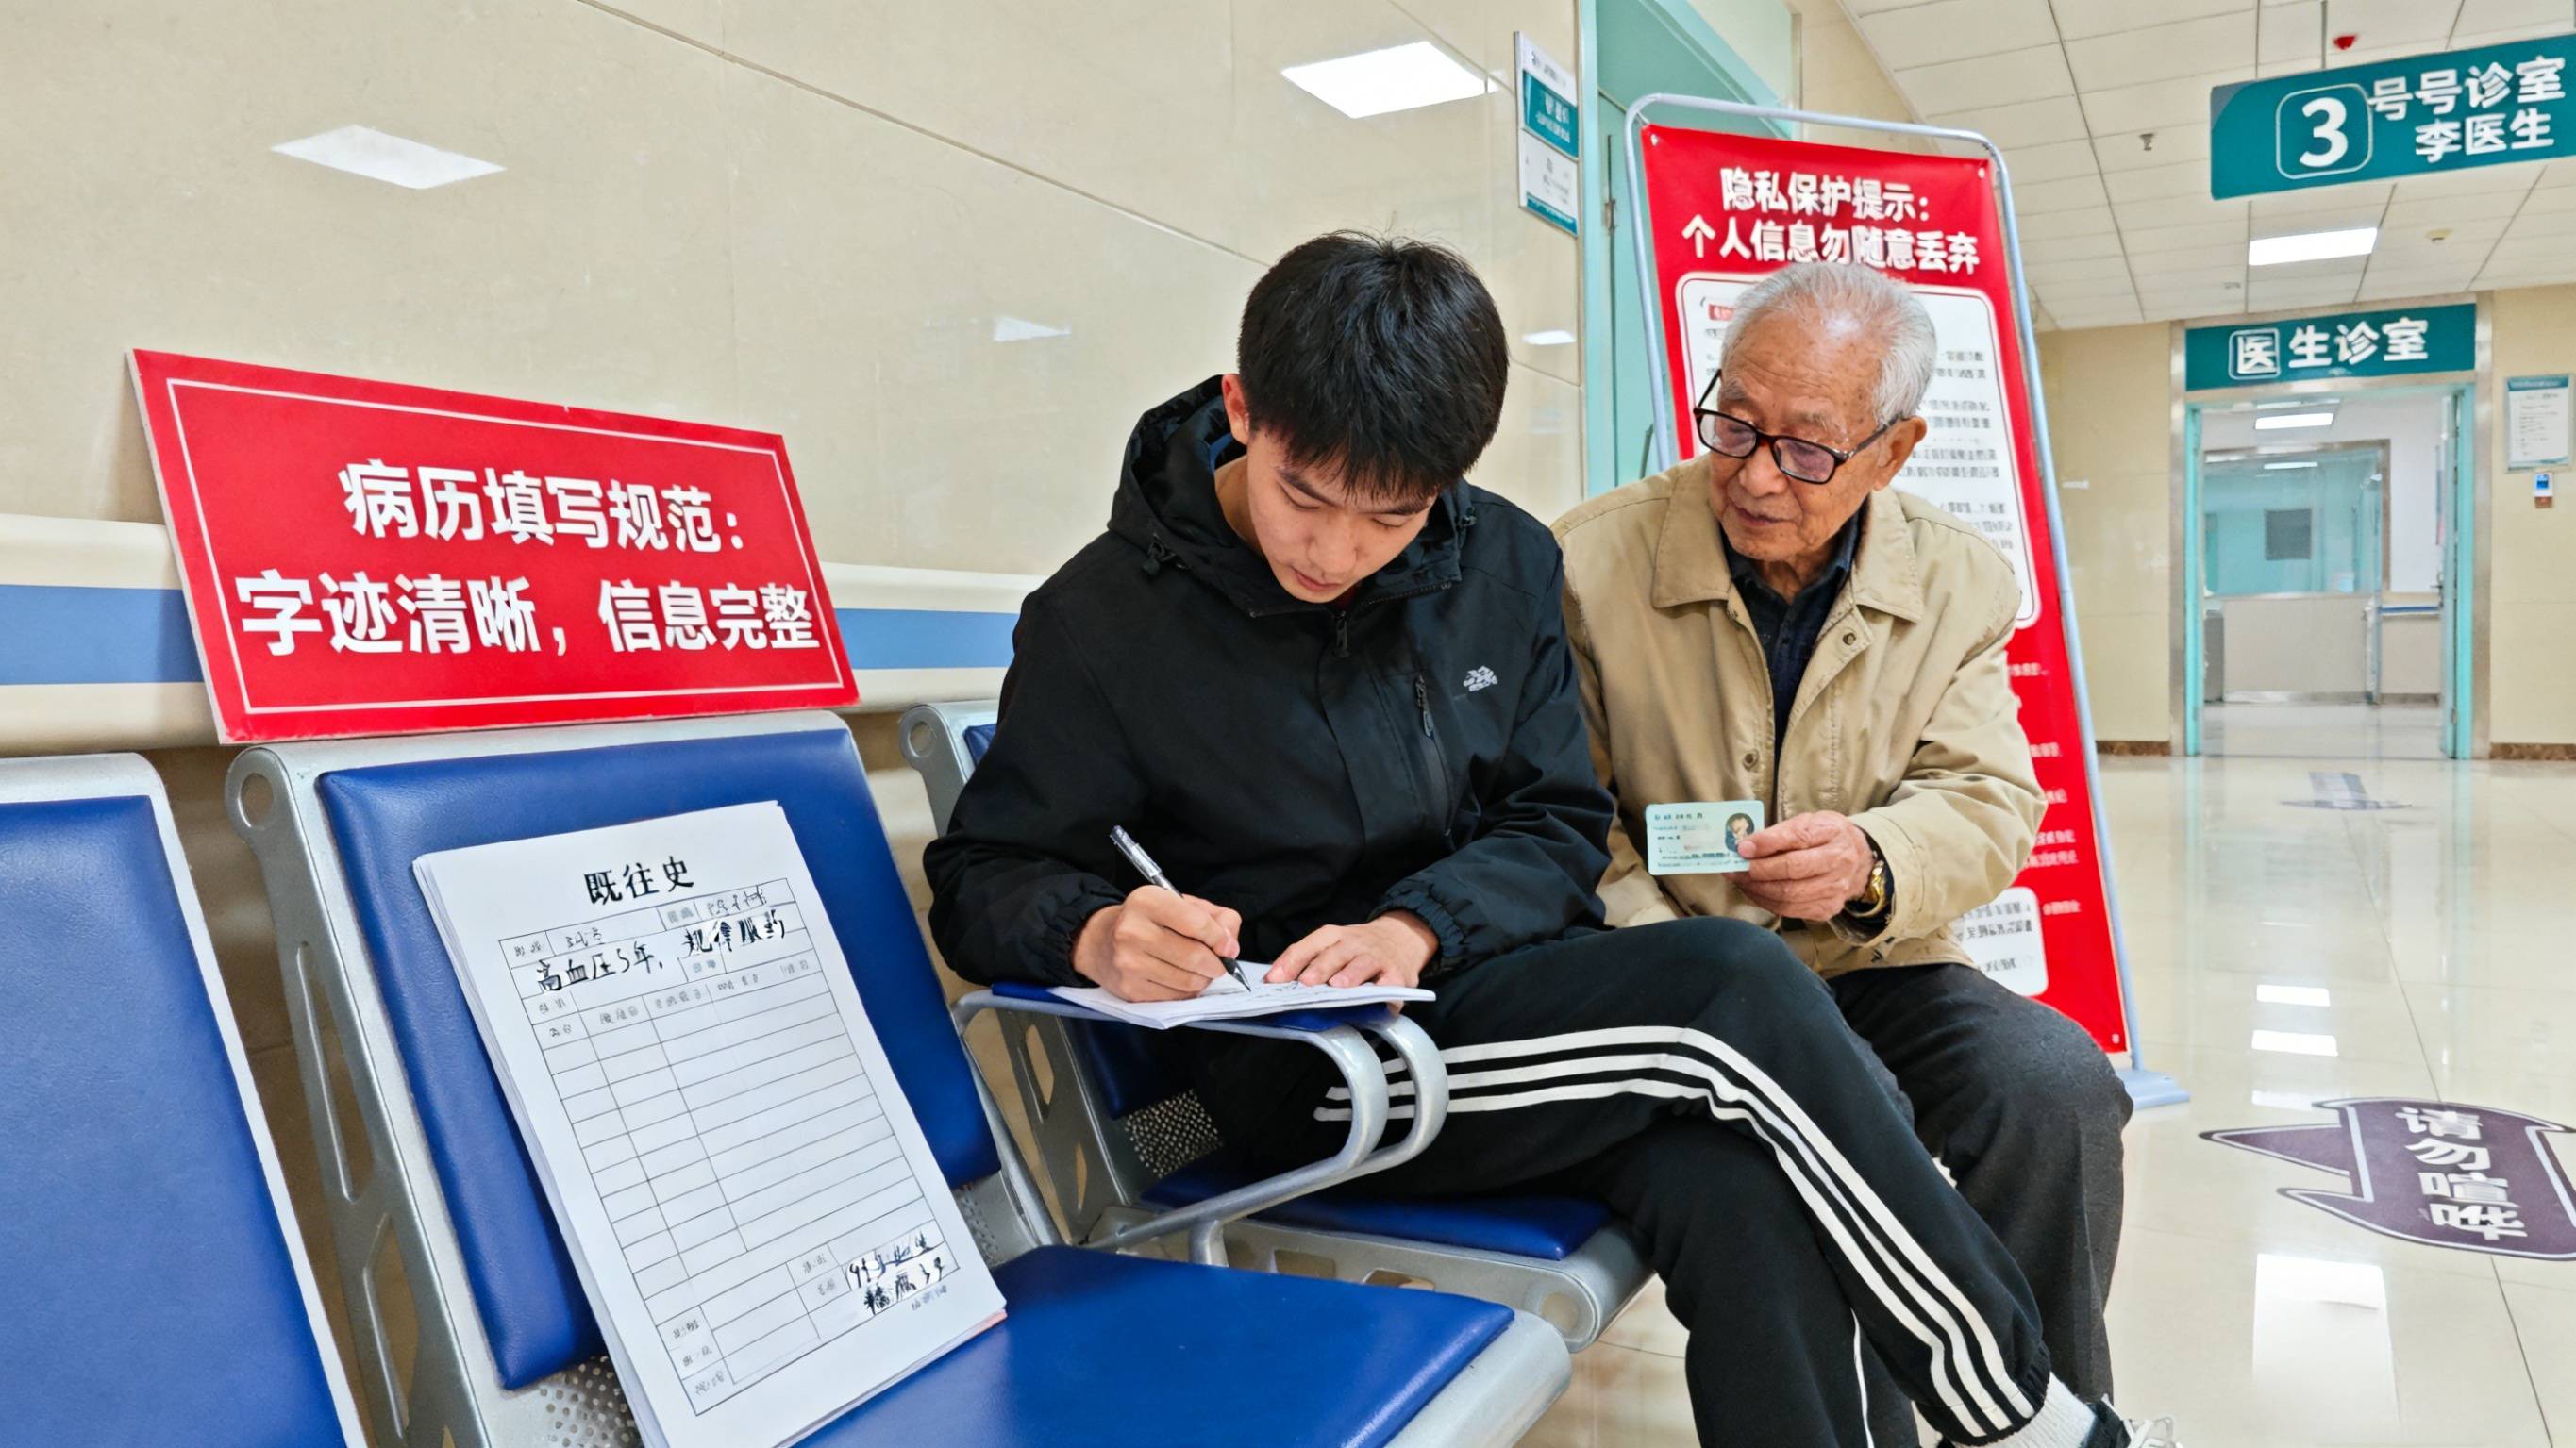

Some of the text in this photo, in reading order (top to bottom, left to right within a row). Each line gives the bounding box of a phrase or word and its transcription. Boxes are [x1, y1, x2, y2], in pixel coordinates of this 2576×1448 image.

[2299, 55, 2566, 168] 3 号号诊室
[2415, 108, 2555, 164] 李医生
[1719, 166, 1930, 222] 隐私保护提示：
[1681, 214, 1980, 274] 个人信息勿随意丢弃
[2237, 318, 2428, 374] 医生诊室
[339, 458, 743, 553] 病历填写规范：
[235, 568, 821, 657] 字迹清晰，信息完整
[583, 856, 694, 906] 既往史
